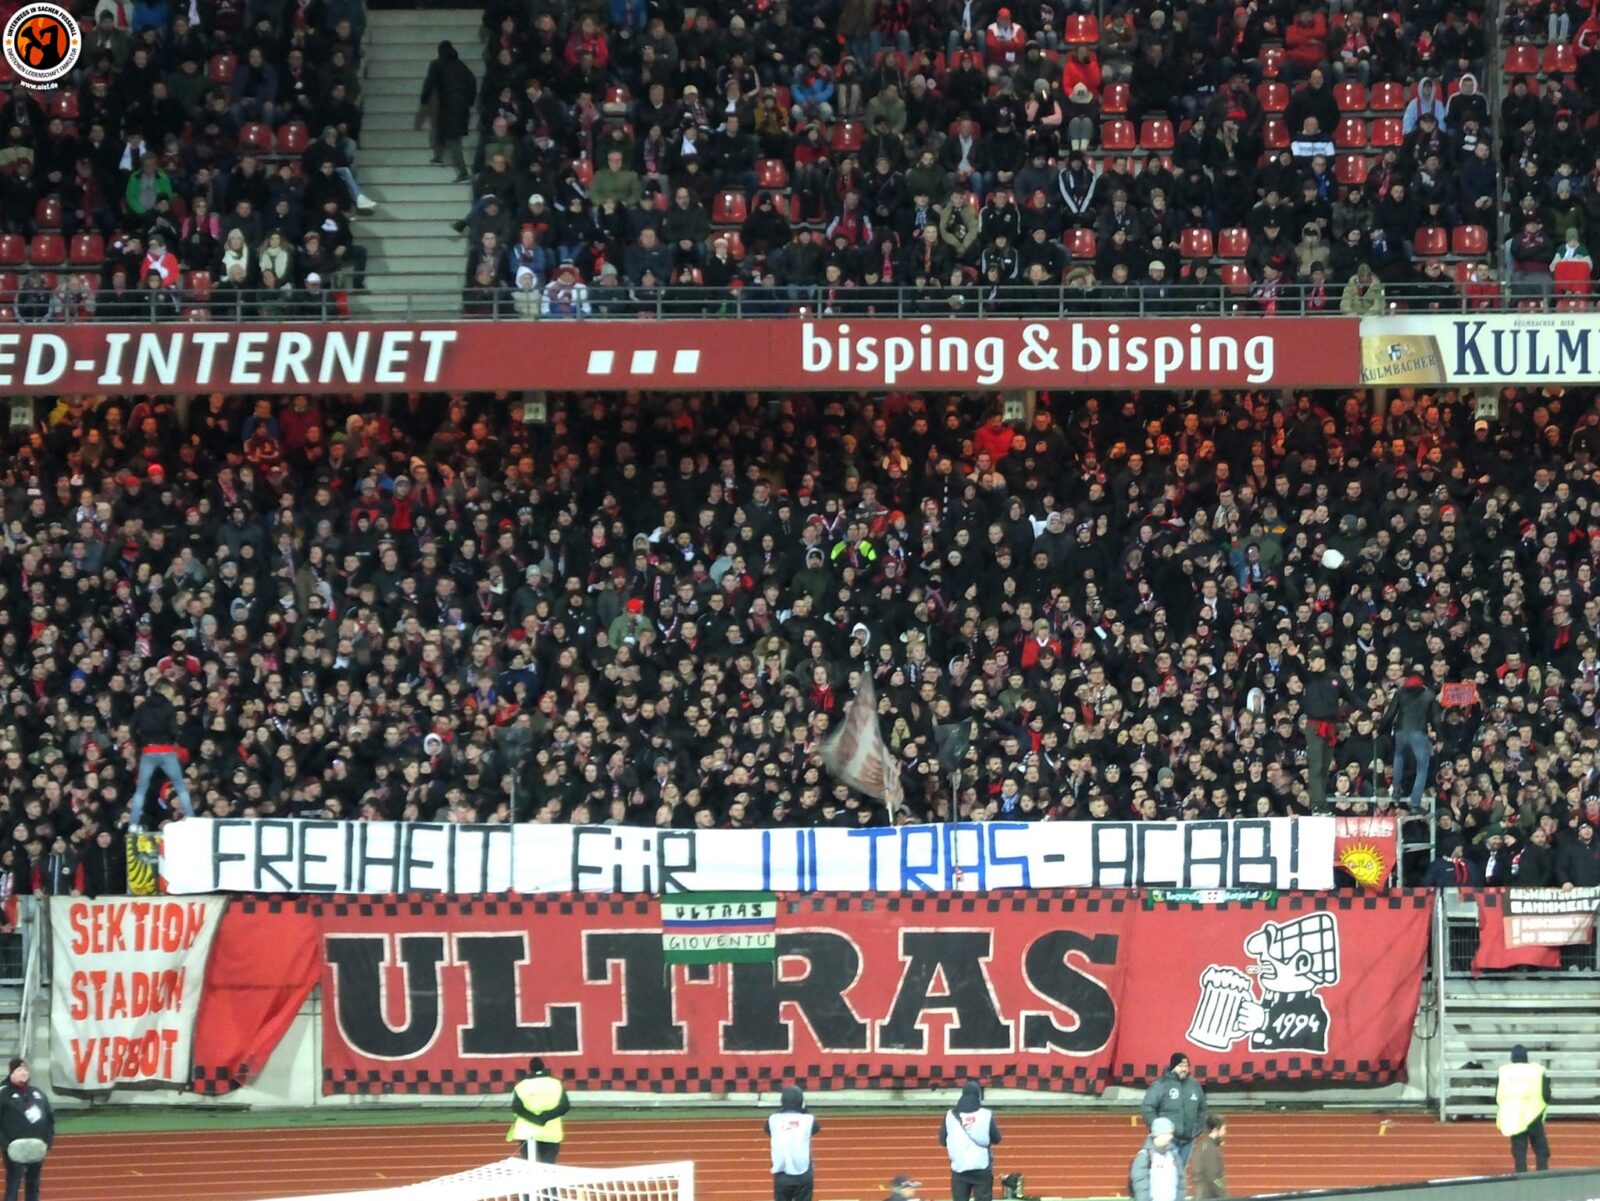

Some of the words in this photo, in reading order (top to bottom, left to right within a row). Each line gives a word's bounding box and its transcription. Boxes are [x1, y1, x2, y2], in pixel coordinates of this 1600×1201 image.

[801, 322, 1005, 386] bisping
[1018, 323, 1060, 371] &
[1070, 322, 1275, 385] bisping
[1360, 354, 1437, 383] KULMBACHER
[213, 820, 514, 895] FREIHEIT
[69, 901, 207, 955] SEKTION
[676, 904, 762, 919] ULTRAS
[325, 928, 1119, 1060] ULTRAS
[1272, 1012, 1321, 1039] 1994
[70, 1029, 179, 1084] VERBOT
